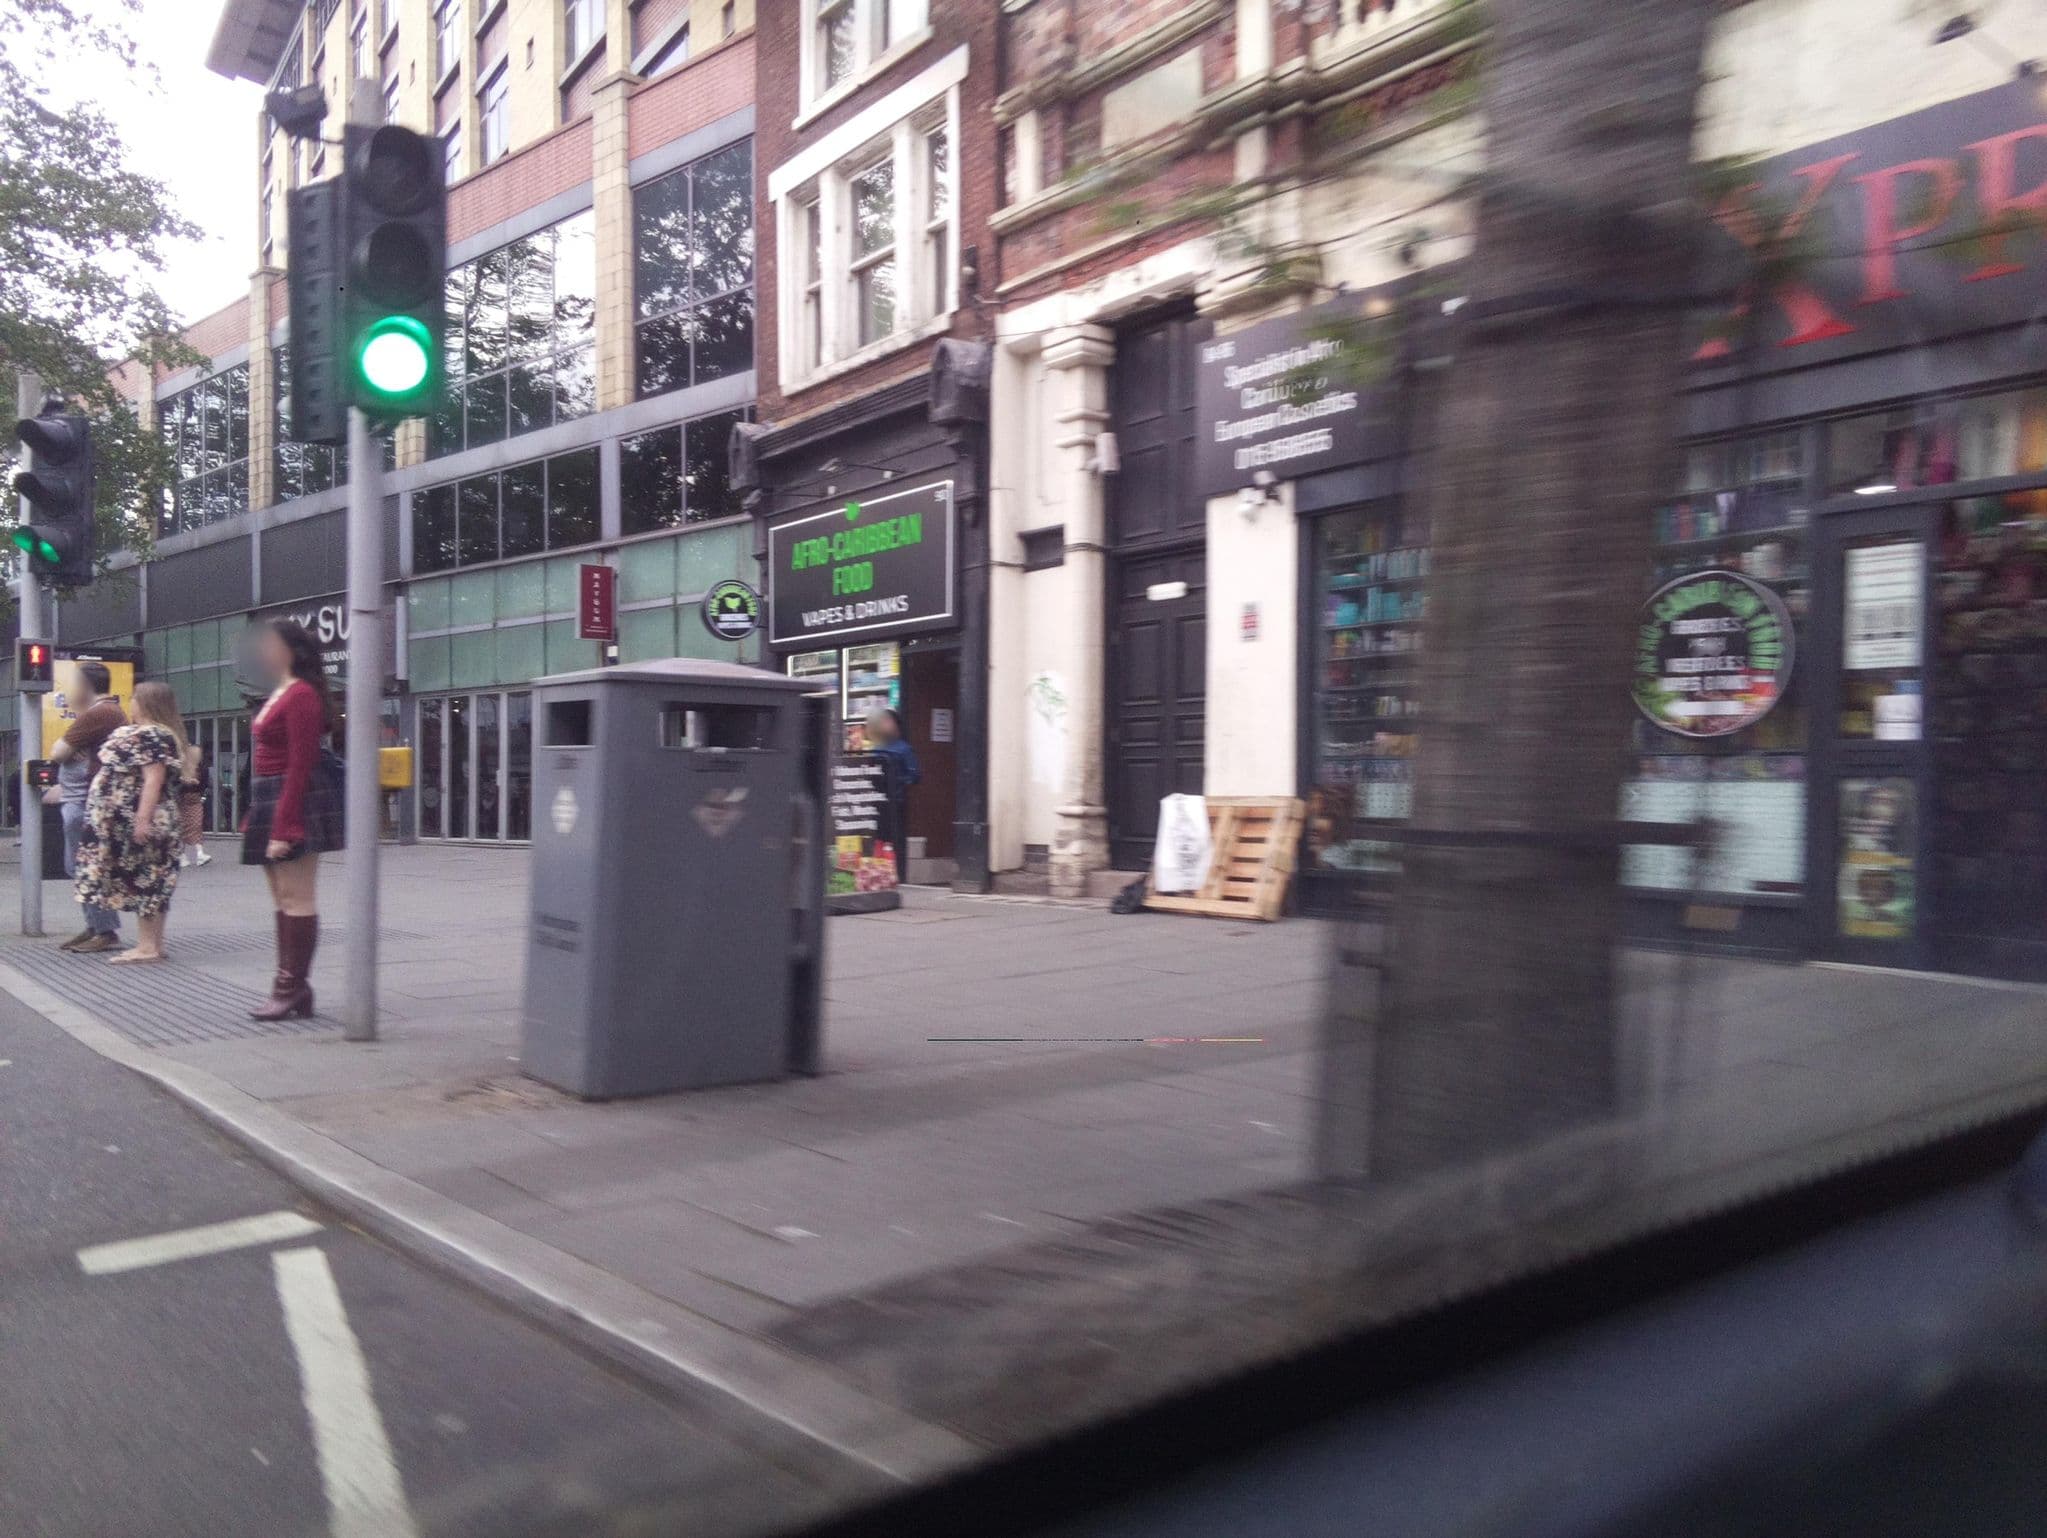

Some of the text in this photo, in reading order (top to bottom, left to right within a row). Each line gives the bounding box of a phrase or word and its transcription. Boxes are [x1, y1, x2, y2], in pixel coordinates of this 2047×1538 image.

[791, 513, 922, 570] AFRO-CARIBBEAN
[832, 561, 874, 596] FOOD
[802, 595, 909, 627] VAPES & DRINKS
